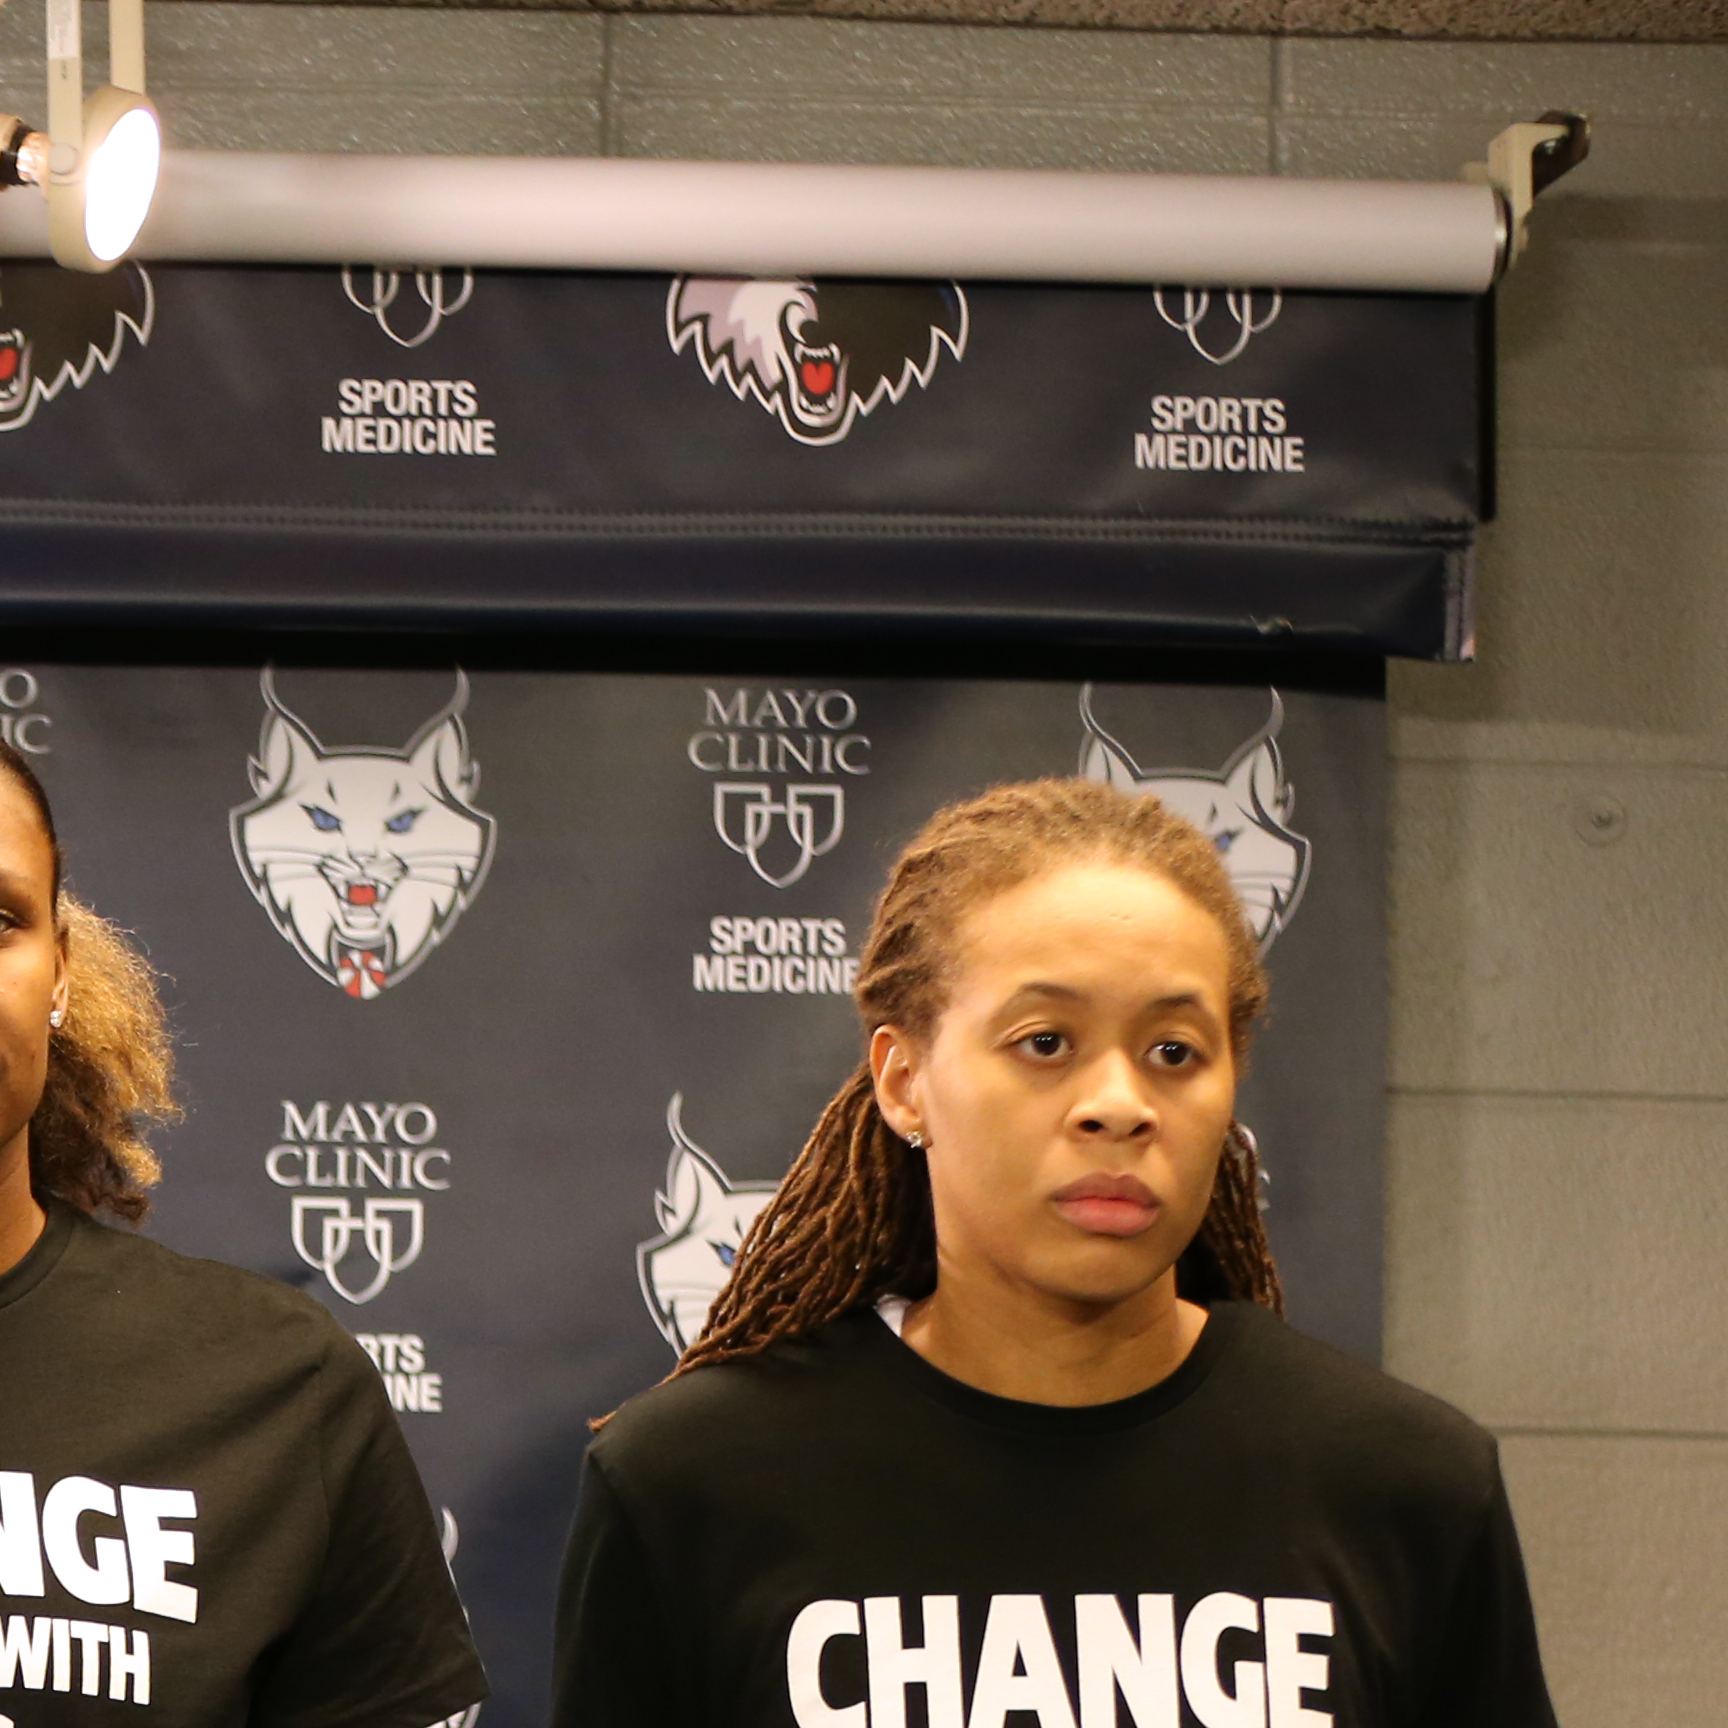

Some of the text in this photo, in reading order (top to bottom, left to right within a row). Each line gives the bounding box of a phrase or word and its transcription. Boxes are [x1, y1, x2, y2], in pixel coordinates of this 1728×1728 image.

[338, 379, 478, 418] SPORTS
[1150, 395, 1287, 435] SPORTS
[321, 416, 496, 456] MEDICINE
[1134, 432, 1306, 473] MEDICINE
[703, 687, 858, 730] MAYO
[687, 731, 872, 776] CLINIC
[709, 916, 847, 956] SPORTS
[281, 1100, 437, 1146] MAYO
[265, 1144, 452, 1192] CLINIC
